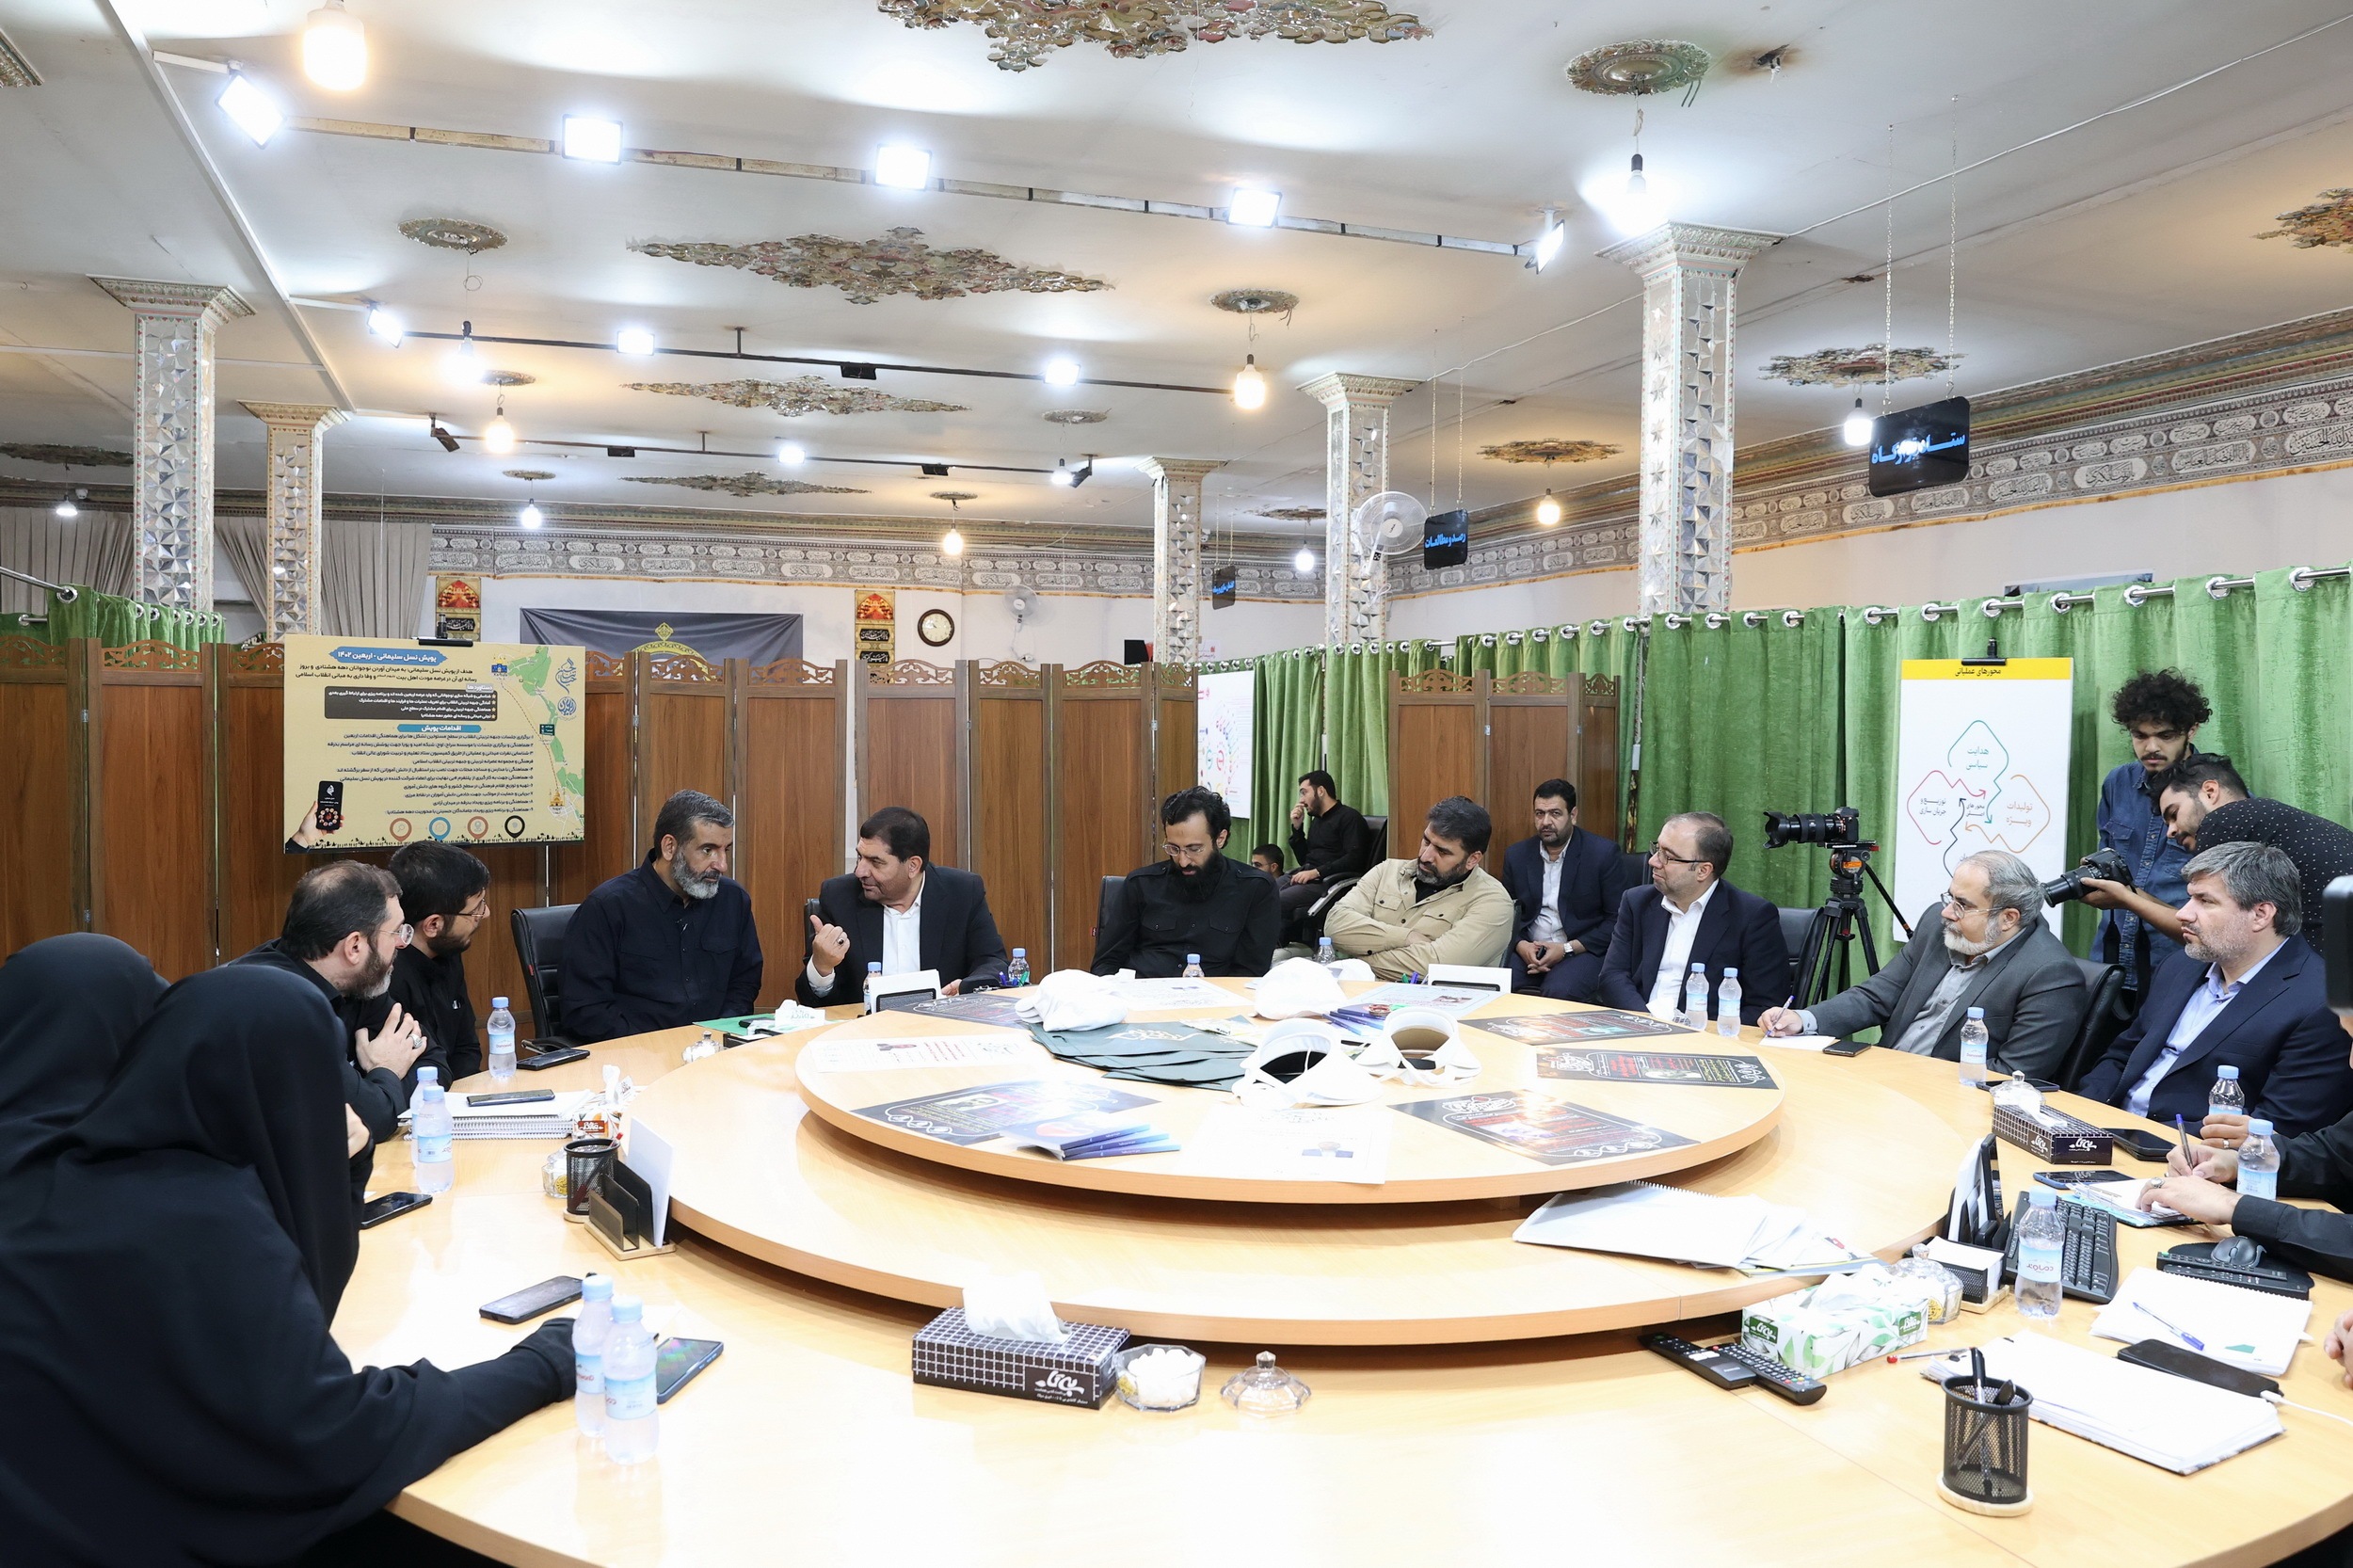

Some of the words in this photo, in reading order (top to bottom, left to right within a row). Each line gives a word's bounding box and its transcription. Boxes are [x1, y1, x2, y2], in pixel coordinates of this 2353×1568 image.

[1920, 432, 1966, 454] ستاد
[1871, 436, 1919, 465] قررگاه
[376, 652, 403, 661] سلیمانی
[403, 653, 418, 662] نسل
[1955, 668, 1976, 677] عملیاتی
[1977, 669, 2001, 678] محورهای
[1966, 745, 1990, 756] هدایت
[1965, 760, 1989, 771] سیاسی
[1932, 808, 1946, 816] جریان
[2007, 802, 2033, 812] تولیدات
[2006, 816, 2032, 827] ویژه
